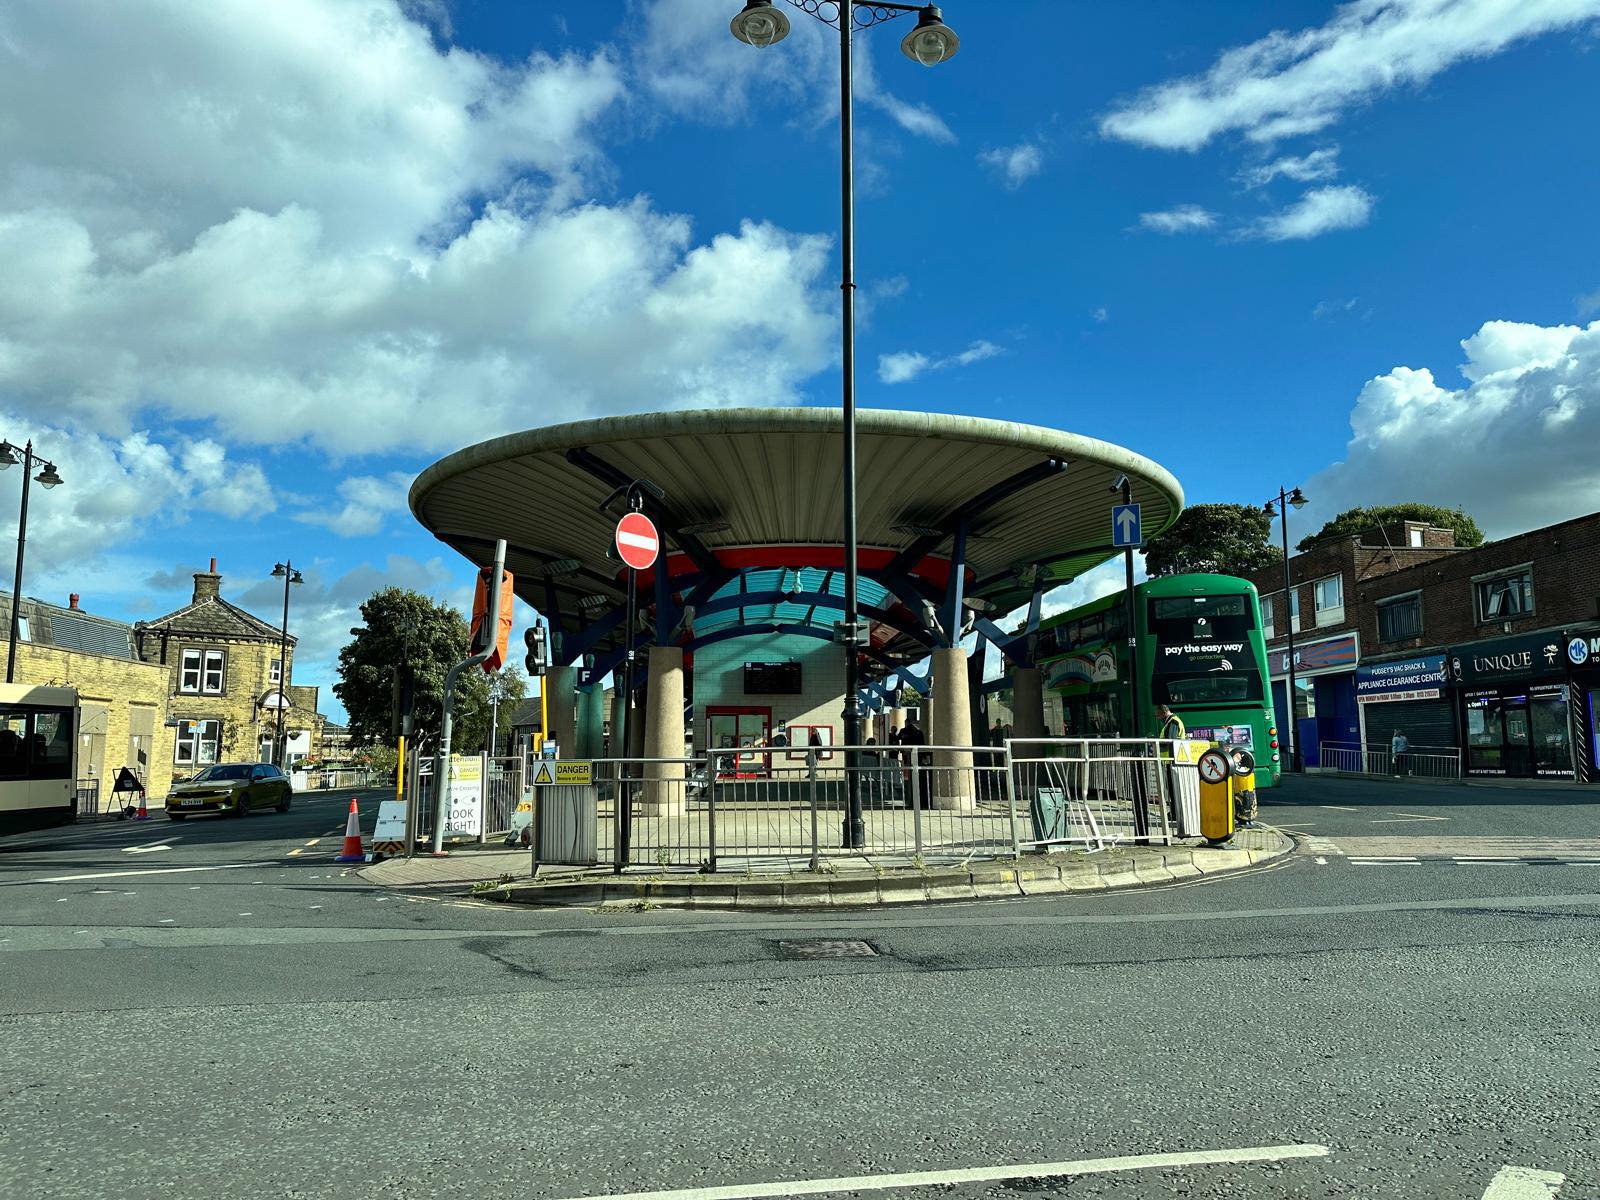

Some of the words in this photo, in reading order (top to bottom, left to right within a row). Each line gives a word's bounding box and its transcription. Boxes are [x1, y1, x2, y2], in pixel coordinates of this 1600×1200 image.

[1165, 646, 1183, 656] pay
[1184, 644, 1200, 654] the
[1201, 644, 1222, 653] easy
[1223, 643, 1243, 653] way
[1474, 652, 1533, 672] UNIQUE
[1371, 667, 1394, 676] PUDSEY'S
[1394, 665, 1404, 673] VAC
[1404, 663, 1421, 671] SHACK
[581, 671, 590, 682] F
[1358, 679, 1387, 690] APPLIANCE
[1387, 675, 1420, 687] CLEARANCE
[1421, 672, 1442, 682] CENTR
[557, 765, 589, 774] DANGER
[447, 809, 474, 820] LOOK
[444, 820, 476, 832] RIGHT!
